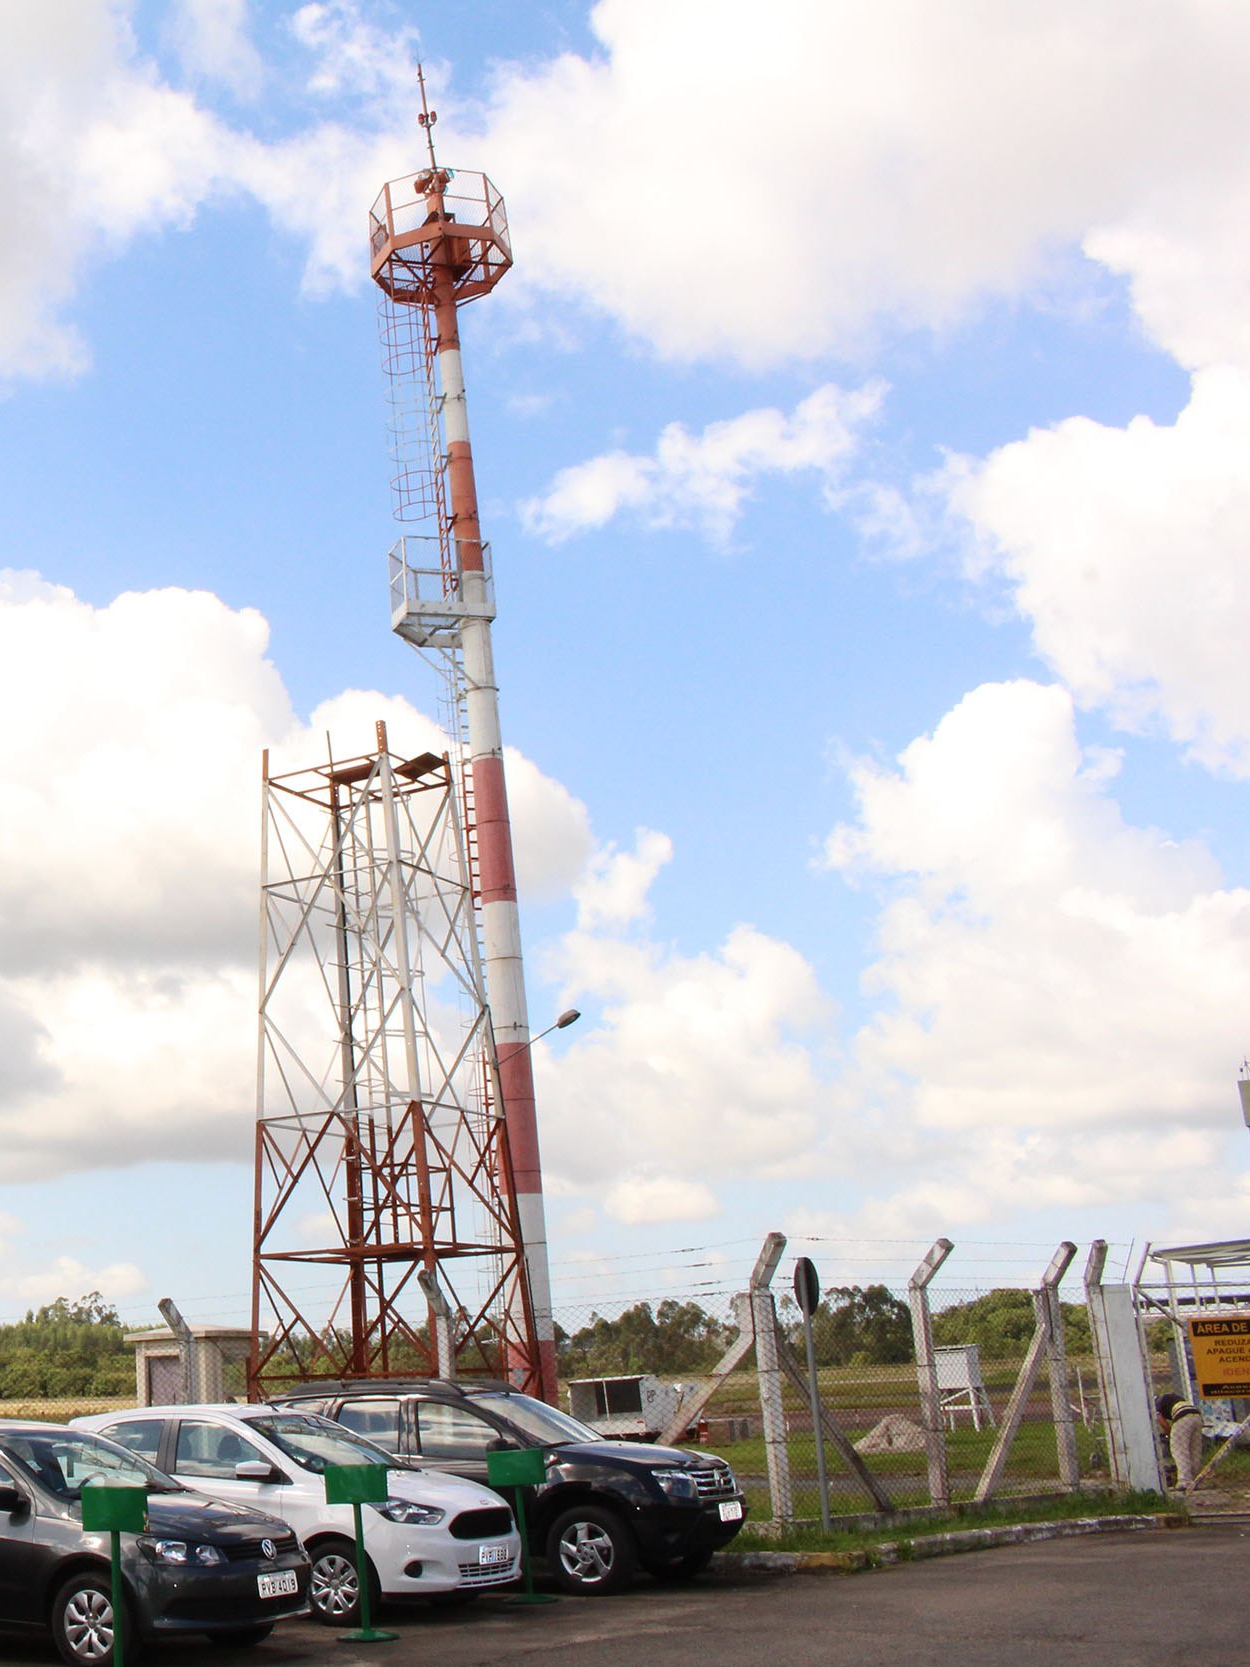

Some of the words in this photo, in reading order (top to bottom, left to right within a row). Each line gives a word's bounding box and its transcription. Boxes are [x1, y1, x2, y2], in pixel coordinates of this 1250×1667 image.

[1197, 1322, 1230, 1334] ÁREA
[1231, 1322, 1248, 1333] DE
[1206, 1347, 1245, 1355] APAGUE
